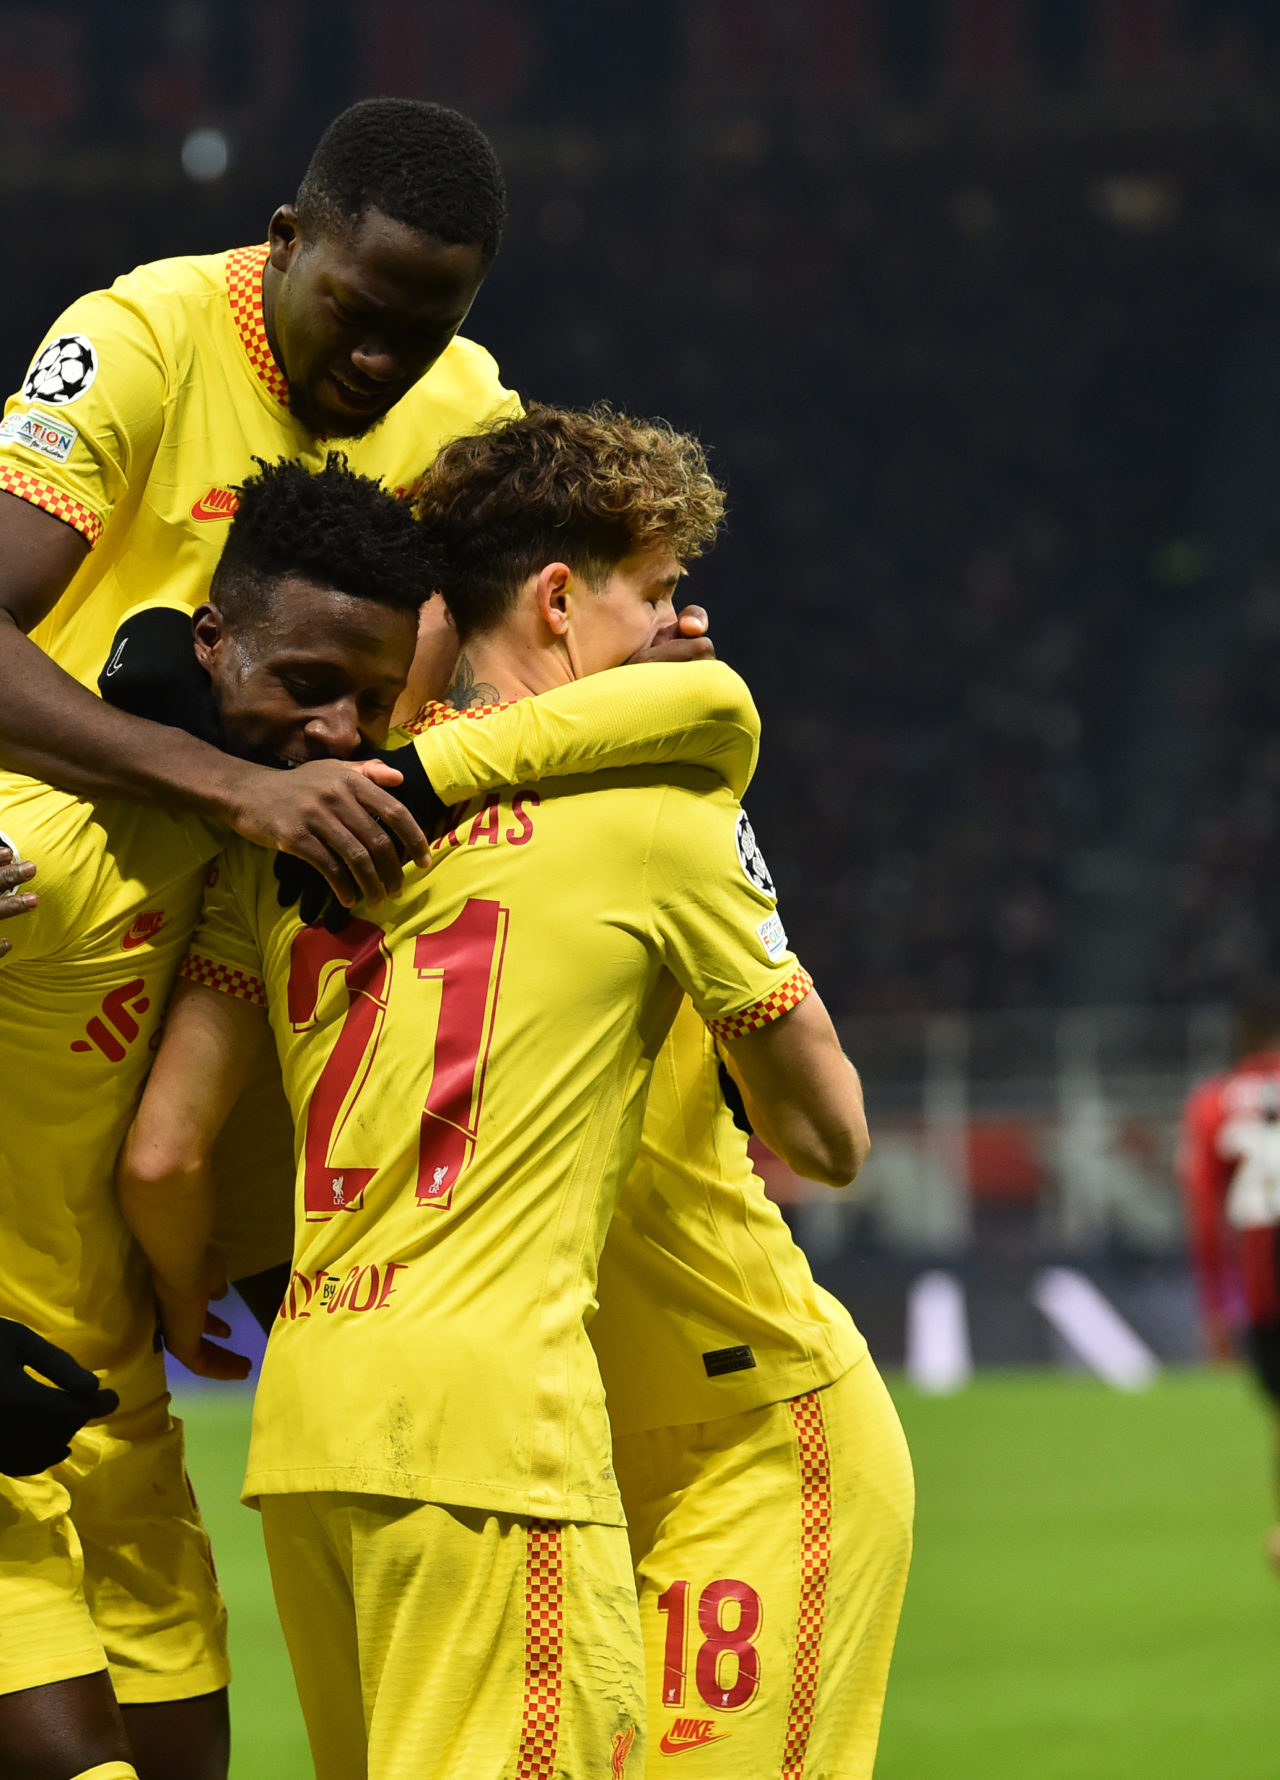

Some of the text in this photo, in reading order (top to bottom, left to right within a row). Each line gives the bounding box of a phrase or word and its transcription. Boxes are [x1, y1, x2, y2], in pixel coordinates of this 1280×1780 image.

[202, 487, 240, 511] NIK
[426, 789, 540, 849] KAS
[287, 898, 510, 1222] 21
[323, 1283, 336, 1299] BY
[658, 1579, 762, 1713] 18
[670, 1718, 715, 1739] NIKE
